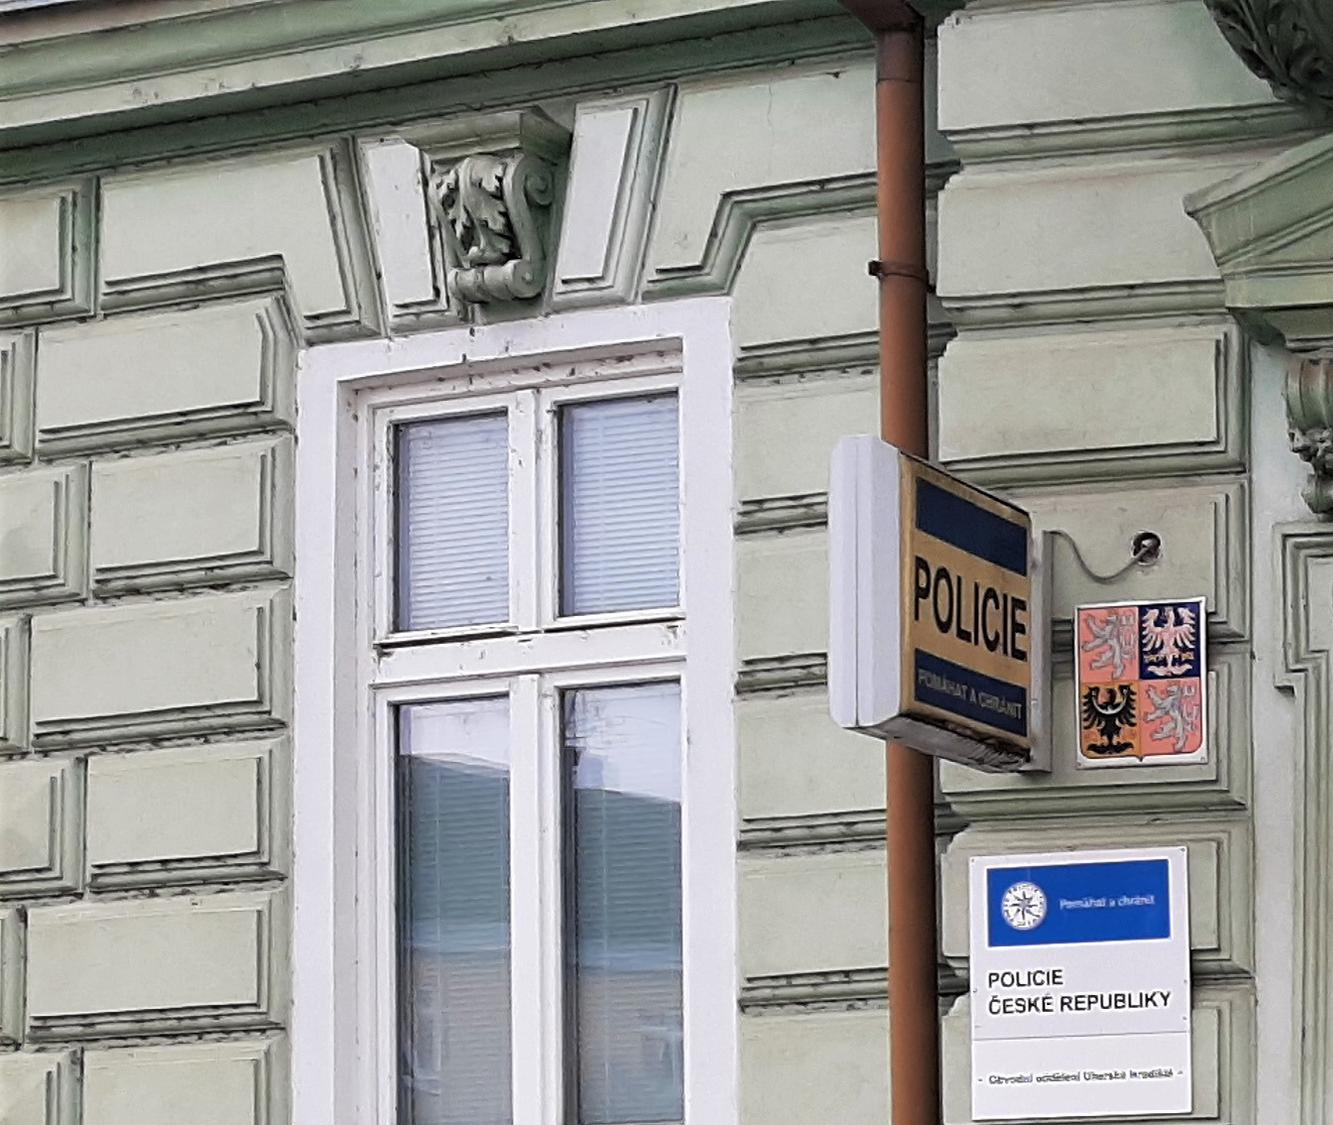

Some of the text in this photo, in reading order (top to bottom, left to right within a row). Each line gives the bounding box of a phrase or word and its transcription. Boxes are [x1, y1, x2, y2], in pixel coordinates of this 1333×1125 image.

[914, 556, 1028, 662] POLICIE
[970, 688, 977, 704] A
[1109, 900, 1116, 908] a
[988, 969, 1064, 989] POLICIE
[988, 991, 1171, 1015] ČESKÉ REPUBLIKY
